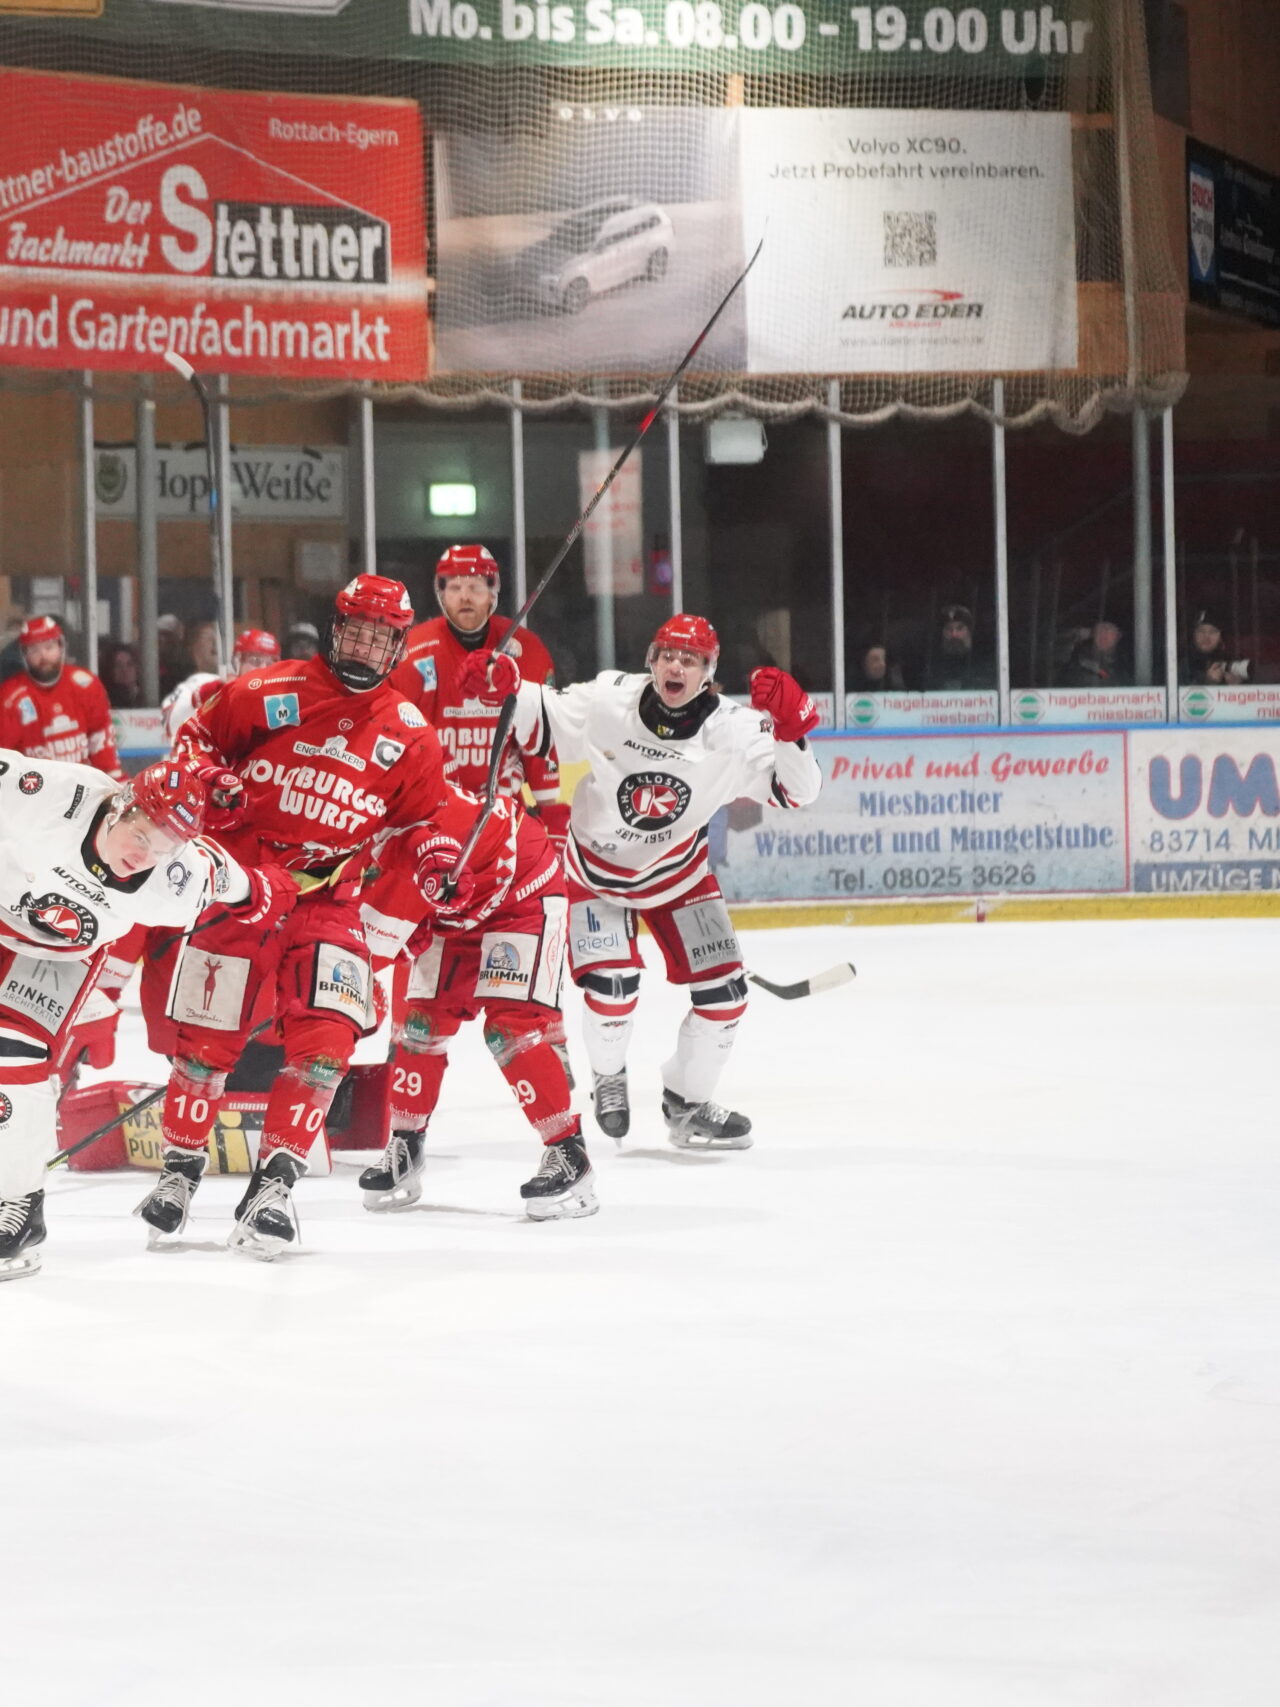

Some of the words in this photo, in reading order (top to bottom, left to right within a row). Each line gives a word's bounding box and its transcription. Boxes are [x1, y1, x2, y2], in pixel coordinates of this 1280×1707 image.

[409, 0, 492, 39] Mo.
[503, 0, 575, 42] bis
[586, 3, 658, 46] Sa.
[666, 5, 806, 51] 08.00
[851, 6, 988, 53] 19.00
[1001, 9, 1093, 54] Uhr
[269, 117, 399, 150] Rottach-Egern
[848, 138, 900, 156] Volvo
[906, 137, 967, 155] XC90.
[769, 163, 817, 180] Jetzt
[823, 162, 923, 180] Probefahrt
[929, 162, 1045, 180] vereinbaren.
[104, 185, 153, 225] Der
[160, 164, 384, 281] Stettner
[6, 222, 151, 269] Fachmarkt
[841, 303, 911, 320] AUTO
[915, 303, 984, 320] EDER
[67, 298, 391, 362] Gartenfachmarkt
[883, 696, 993, 713] hagebaumarkt
[1048, 692, 1163, 709] hagebaumarkt
[1087, 707, 1163, 721] miesbach
[921, 712, 996, 726] miesbach
[375, 740, 403, 767] C
[831, 755, 915, 781] Privat
[925, 752, 980, 779] und
[991, 750, 1109, 783] Gewerbe
[278, 788, 369, 835] WURST
[859, 789, 1004, 818] Miesbacher
[755, 828, 883, 859] Wäscherei
[891, 827, 941, 854] und
[951, 822, 1114, 854] Mangelstube
[1149, 829, 1232, 853] 83714
[830, 868, 873, 892] Tel.
[882, 866, 963, 889] 08025
[972, 863, 1036, 887] 3626
[577, 932, 619, 952] Riedl
[691, 937, 737, 959] RINKES
[479, 969, 529, 983] BRUMMI
[6, 980, 65, 1019] RINKES
[392, 1067, 423, 1097] 29
[174, 1094, 209, 1123] 10
[289, 1102, 325, 1132] 10
